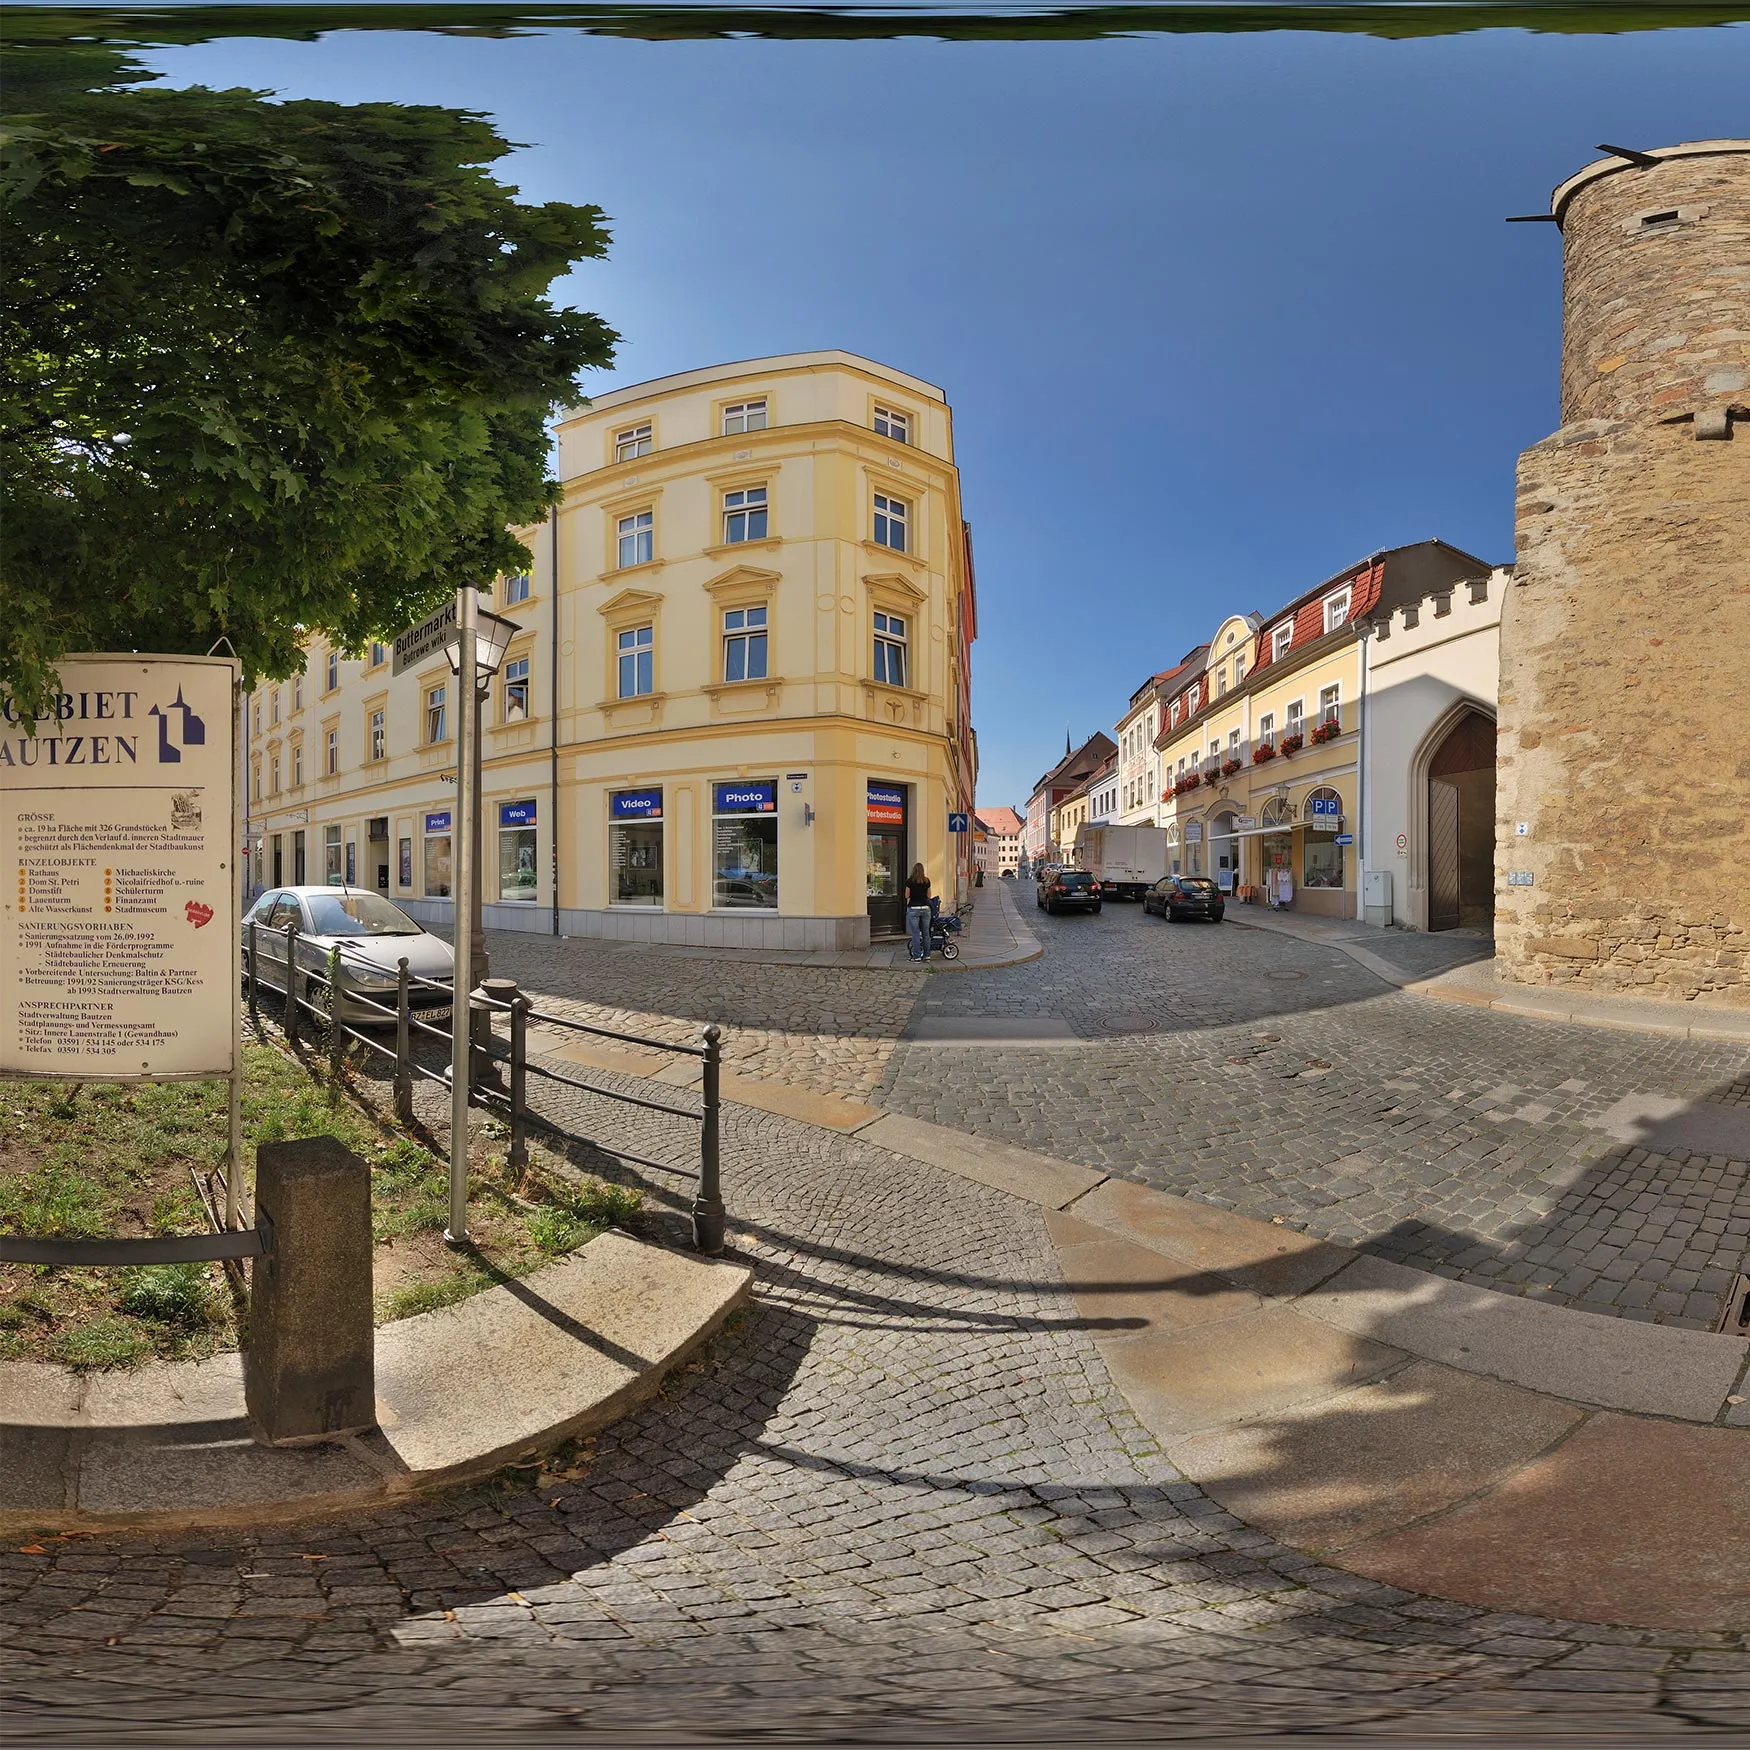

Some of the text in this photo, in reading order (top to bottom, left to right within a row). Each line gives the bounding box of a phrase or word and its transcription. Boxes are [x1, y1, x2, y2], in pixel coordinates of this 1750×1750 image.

[396, 603, 457, 655] Buttermarkt
[403, 629, 447, 666] Butrowe wiki
[726, 791, 763, 803] Photo
[621, 799, 651, 809] Video
[1315, 800, 1323, 813] P
[1328, 801, 1336, 813] P
[18, 812, 55, 821] GRÖSSE
[509, 809, 526, 819] Web
[430, 818, 445, 826] Print
[47, 824, 56, 832] ha
[58, 824, 83, 832] Fläche
[84, 824, 97, 832] mit
[99, 824, 113, 832] 326
[114, 824, 167, 832] Grundstücken
[24, 834, 56, 843] begrenzt
[95, 833, 122, 841] Verlauf
[160, 833, 205, 841] Stadtmauer
[24, 844, 59, 852] geschützt
[60, 843, 71, 851] als
[73, 843, 135, 851] Flächendenkmal
[149, 842, 204, 850] Stadtbaukunst
[19, 858, 97, 866] EINZELOBJEKTE
[29, 878, 47, 886] Dom
[61, 878, 80, 886] Petri
[115, 878, 173, 886] Nicolaifriedhof
[115, 887, 164, 895] Schülerturm
[29, 896, 71, 904] Lauenturm
[115, 896, 157, 904] Finanzamt
[29, 905, 44, 913] Alte
[46, 905, 93, 913] Wasserkunst
[115, 905, 167, 913] Stadtmuseum
[18, 922, 133, 930] SANIERUNGSVORHABEN
[25, 932, 94, 941] Sanierungssatzung
[113, 933, 155, 941] 26.09.1992
[25, 941, 42, 949] 1991
[106, 942, 174, 950] Förderprogramme
[45, 951, 164, 959] Städtebaulicher Denkmalschutz
[45, 960, 146, 969] Städtebauliche Erneuerung
[25, 968, 77, 976] Vorbereitende
[79, 969, 134, 978] Untersuchung:
[135, 969, 159, 977] Baltin
[25, 977, 204, 987] Betreuung: 1991/92 Sanierungsträger KSG/Kess
[79, 987, 97, 995] 1993
[97, 987, 160, 996] Stadtverwaltung
[161, 987, 193, 995] Bautzen
[18, 1001, 114, 1010] ANSPRECHPARTNER
[18, 1011, 79, 1021] Stadtverwaltung
[18, 1020, 75, 1029] Stadtplanungs-
[91, 1021, 156, 1030] Vermessungsamt
[25, 1028, 42, 1036] Sitz:
[44, 1029, 68, 1037] Innere
[70, 1030, 117, 1038] Lauenstraße
[124, 1030, 179, 1038] (Gewandhaus)
[25, 1036, 52, 1044] Telefon
[25, 1045, 52, 1053] Telefax
[86, 1047, 100, 1055] 534
